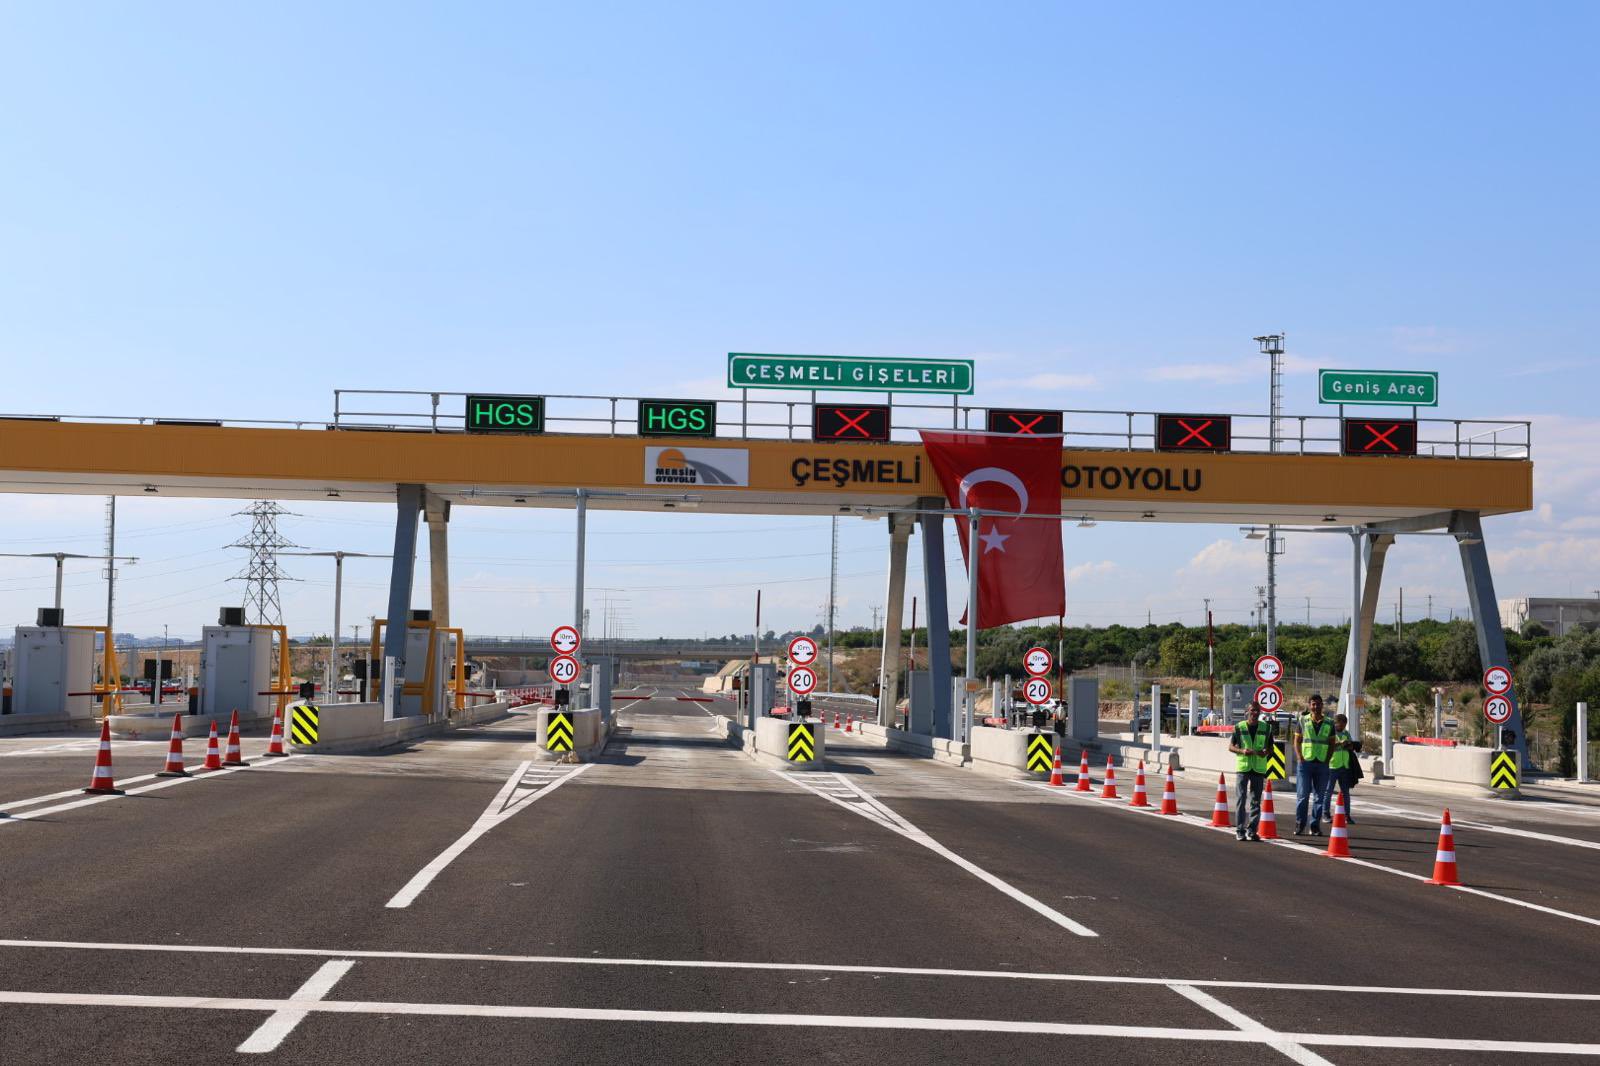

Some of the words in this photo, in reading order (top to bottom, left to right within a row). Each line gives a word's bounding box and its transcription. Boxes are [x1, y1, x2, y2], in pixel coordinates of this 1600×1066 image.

[746, 364, 842, 381] ÇEŞMELİ
[853, 365, 955, 384] GİŞELERİ
[1332, 381, 1380, 395] Geniş
[1387, 382, 1425, 397] Araç
[475, 403, 533, 426] HGS
[649, 407, 706, 430] HGS
[655, 467, 697, 476] MERSİN
[791, 455, 921, 487] ÇEŞMELİ
[1061, 465, 1202, 492] OTOYOLU
[655, 475, 697, 484] OTOYOLU
[556, 662, 574, 676] 20
[793, 673, 811, 687] 20
[1029, 683, 1046, 697] 20
[1260, 691, 1277, 705] 20
[1489, 702, 1506, 716] 20
